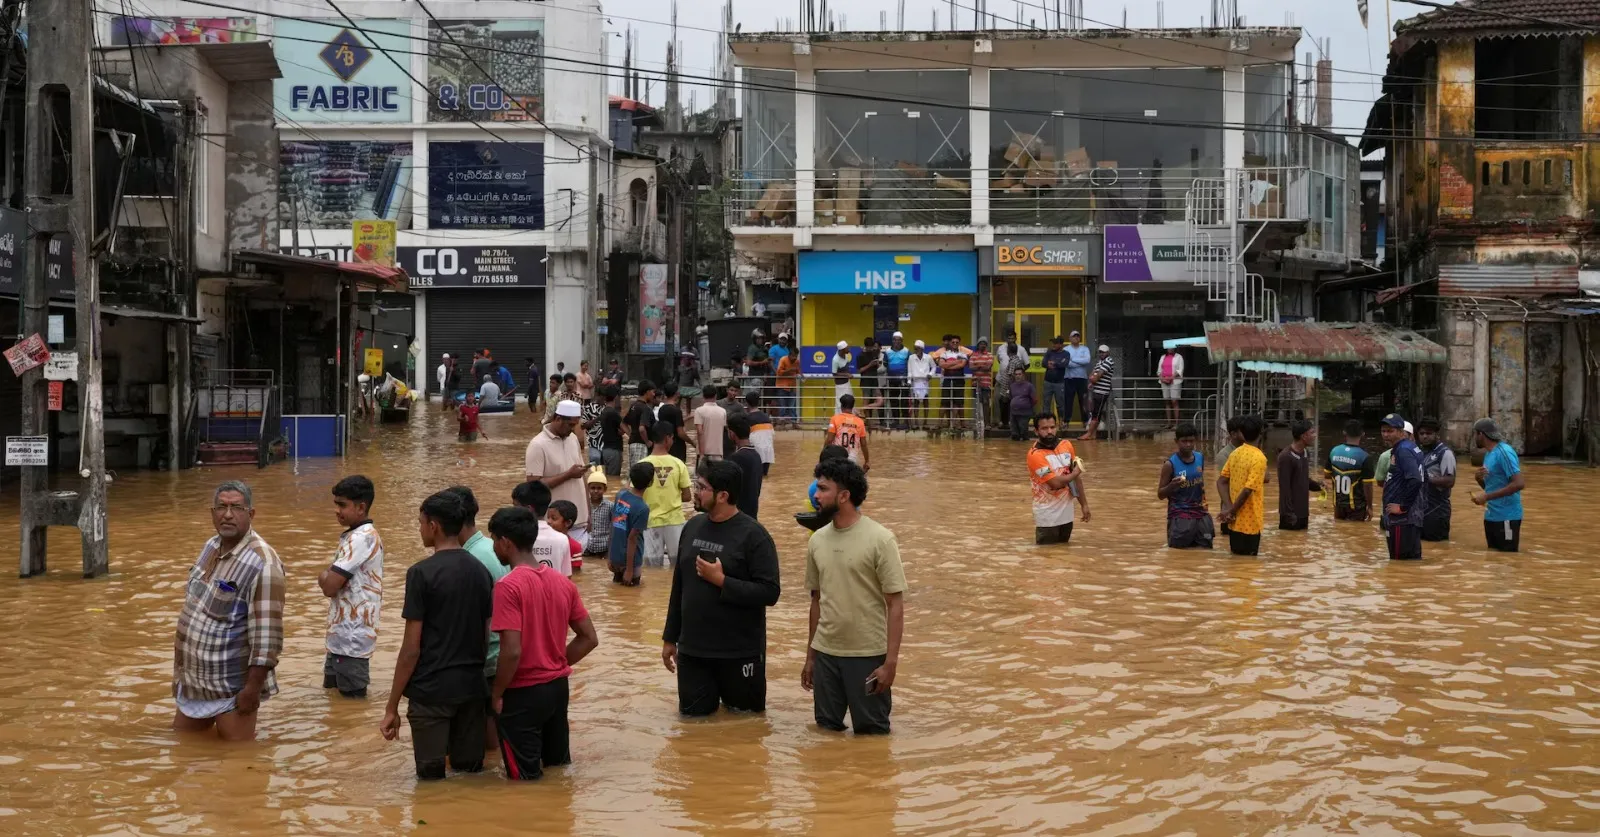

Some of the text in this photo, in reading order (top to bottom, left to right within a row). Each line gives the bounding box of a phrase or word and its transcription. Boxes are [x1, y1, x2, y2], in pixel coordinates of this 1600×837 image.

[290, 84, 399, 111] FABRIC
[437, 84, 511, 111] & CO.
[417, 248, 467, 275] CO.
[998, 245, 1042, 264] BOC
[472, 275, 518, 284] 0775 655 959
[855, 270, 906, 290] HNB
[842, 432, 856, 449] 04
[1334, 474, 1352, 495] 10
[742, 662, 754, 678] 07
